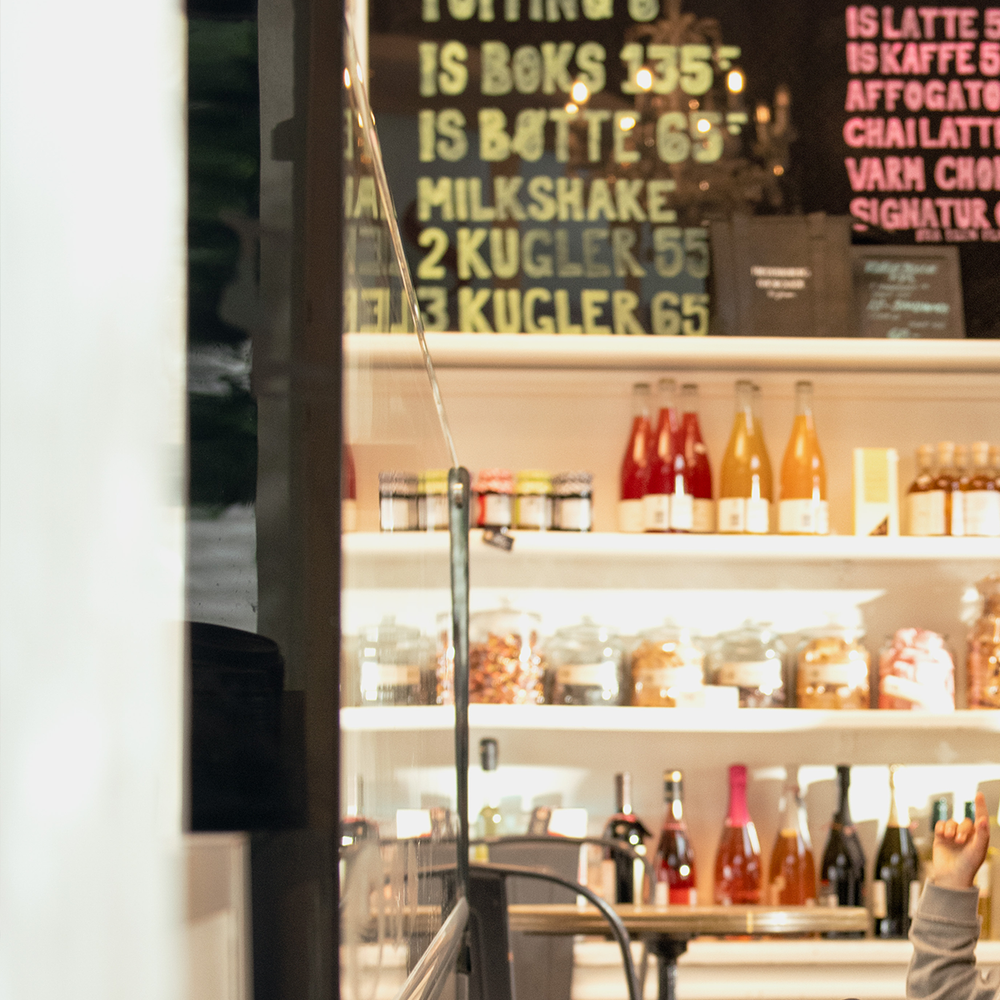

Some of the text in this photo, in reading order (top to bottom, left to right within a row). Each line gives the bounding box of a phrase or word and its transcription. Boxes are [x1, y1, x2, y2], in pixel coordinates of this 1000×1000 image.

[847, 6, 879, 40] IS
[881, 6, 979, 40] LATTE
[418, 40, 468, 97] IS
[847, 41, 879, 75] IS
[880, 41, 976, 76] KAFFE
[418, 109, 469, 162] IS
[846, 156, 926, 192] VARM
[416, 176, 678, 223] MILKSHAKE
[850, 197, 990, 232] SIGNATUR
[417, 227, 449, 280] 2
[456, 227, 647, 279] KUGLER
[457, 287, 648, 335] KUGLER
